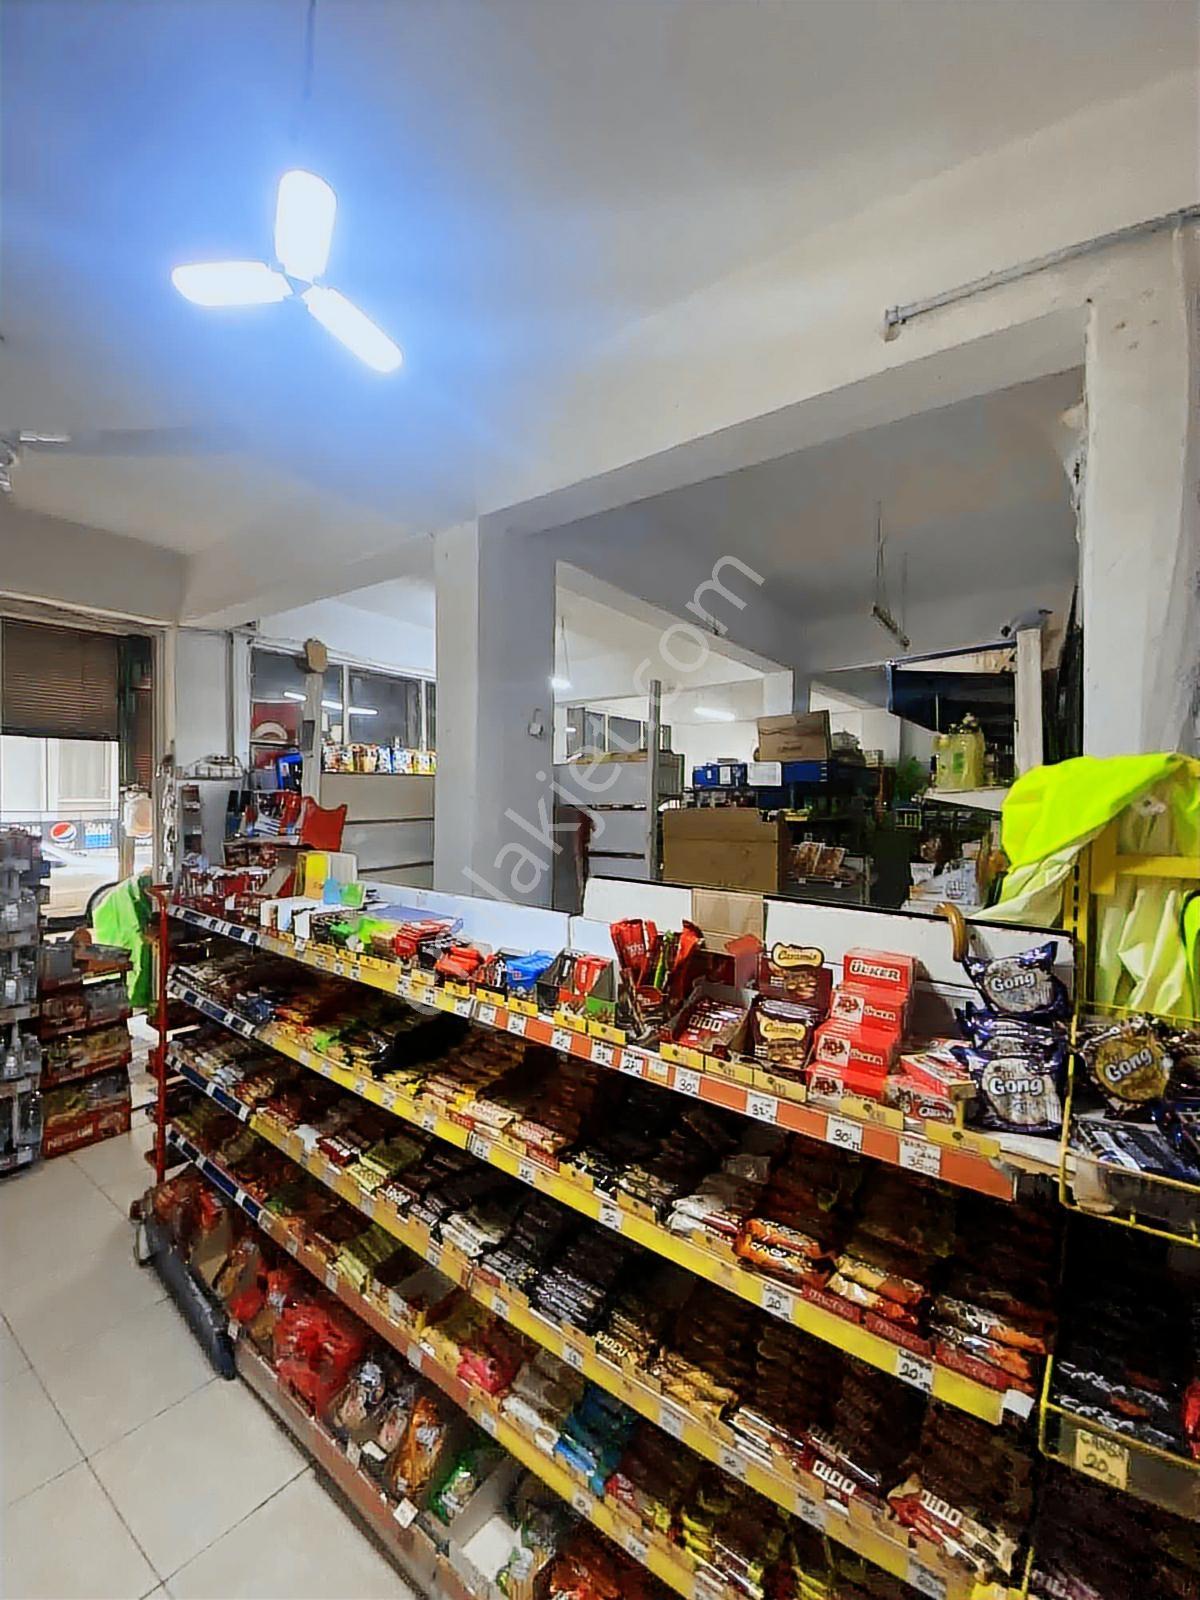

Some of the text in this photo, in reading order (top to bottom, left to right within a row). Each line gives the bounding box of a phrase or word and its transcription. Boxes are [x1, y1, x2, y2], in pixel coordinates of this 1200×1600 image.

[851, 959, 900, 981] ÜLKER
[990, 972, 1036, 993] Gong
[1104, 1048, 1153, 1083] Gong
[988, 1078, 1045, 1096] Gong
